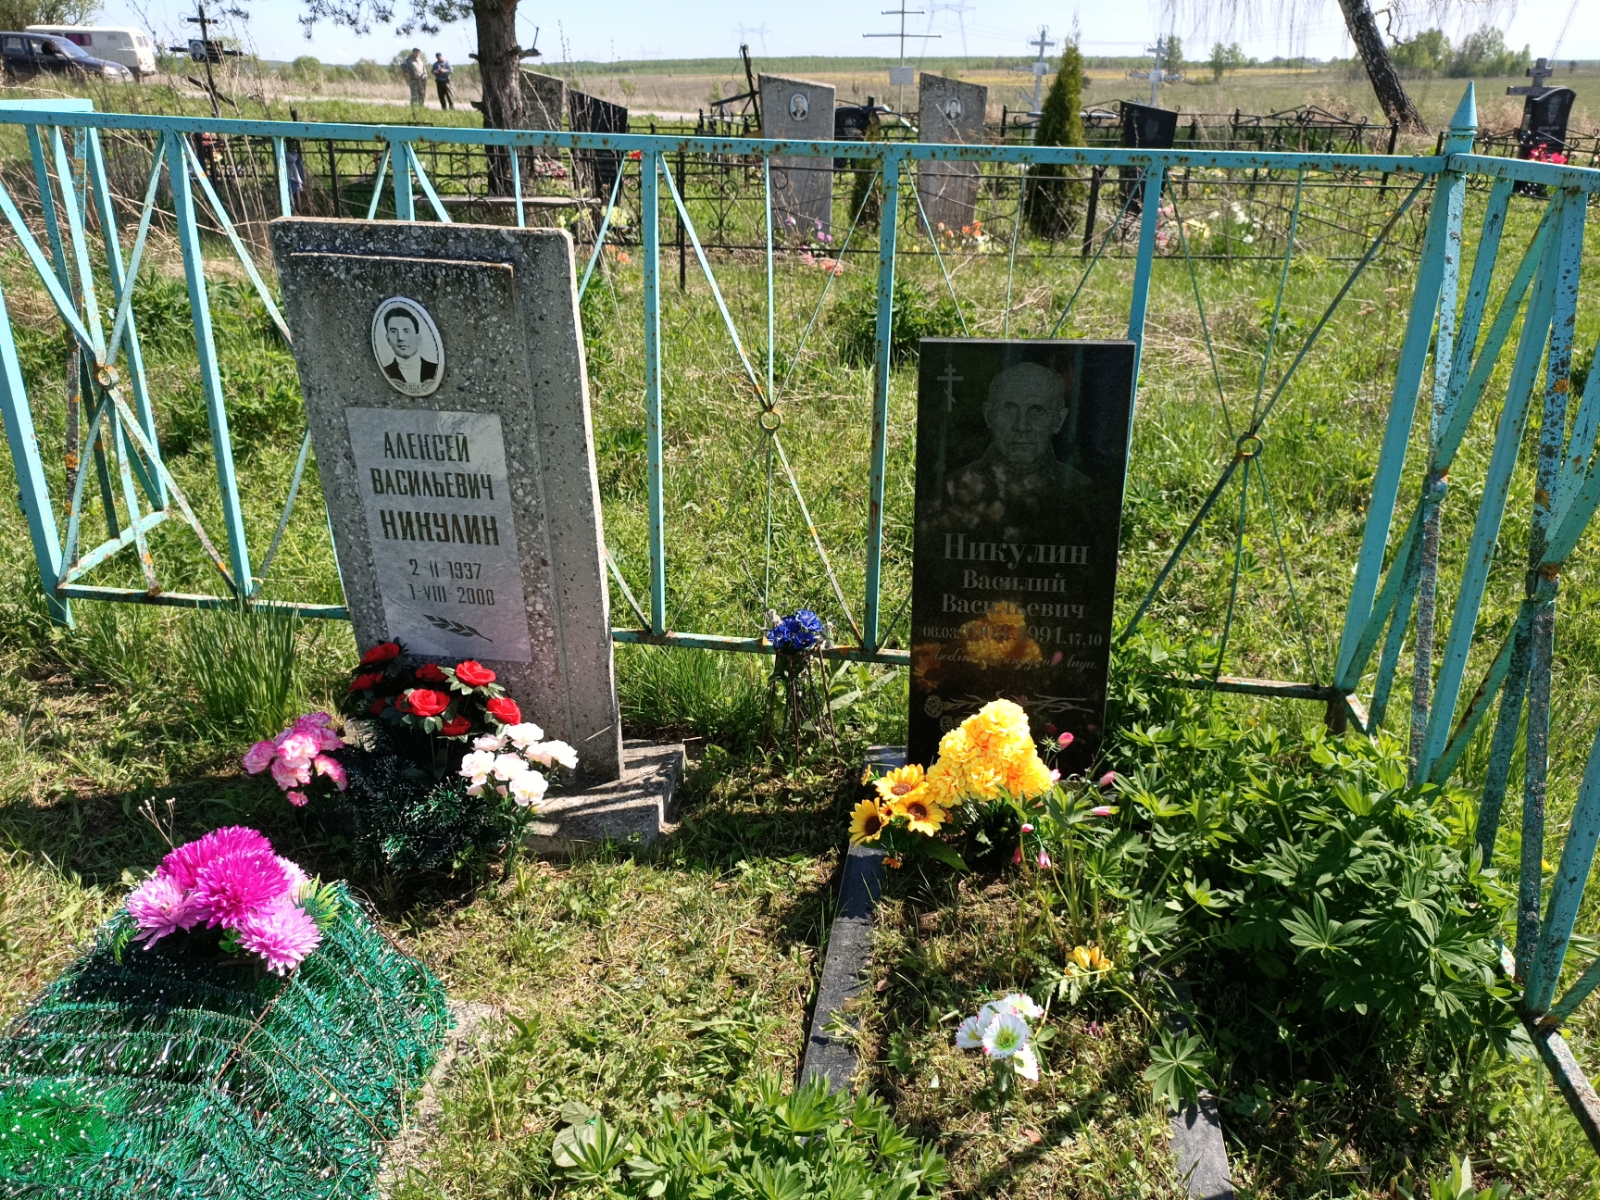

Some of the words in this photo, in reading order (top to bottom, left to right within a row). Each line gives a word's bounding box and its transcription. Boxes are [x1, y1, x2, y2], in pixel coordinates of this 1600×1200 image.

[384, 432, 470, 463] АЛЕКСЕЙ
[370, 467, 494, 500] ВАСИЛЬЕВИЧ
[379, 510, 500, 546] НИКУЛИН
[943, 533, 1091, 570] Никулин
[962, 569, 1067, 593] Василий
